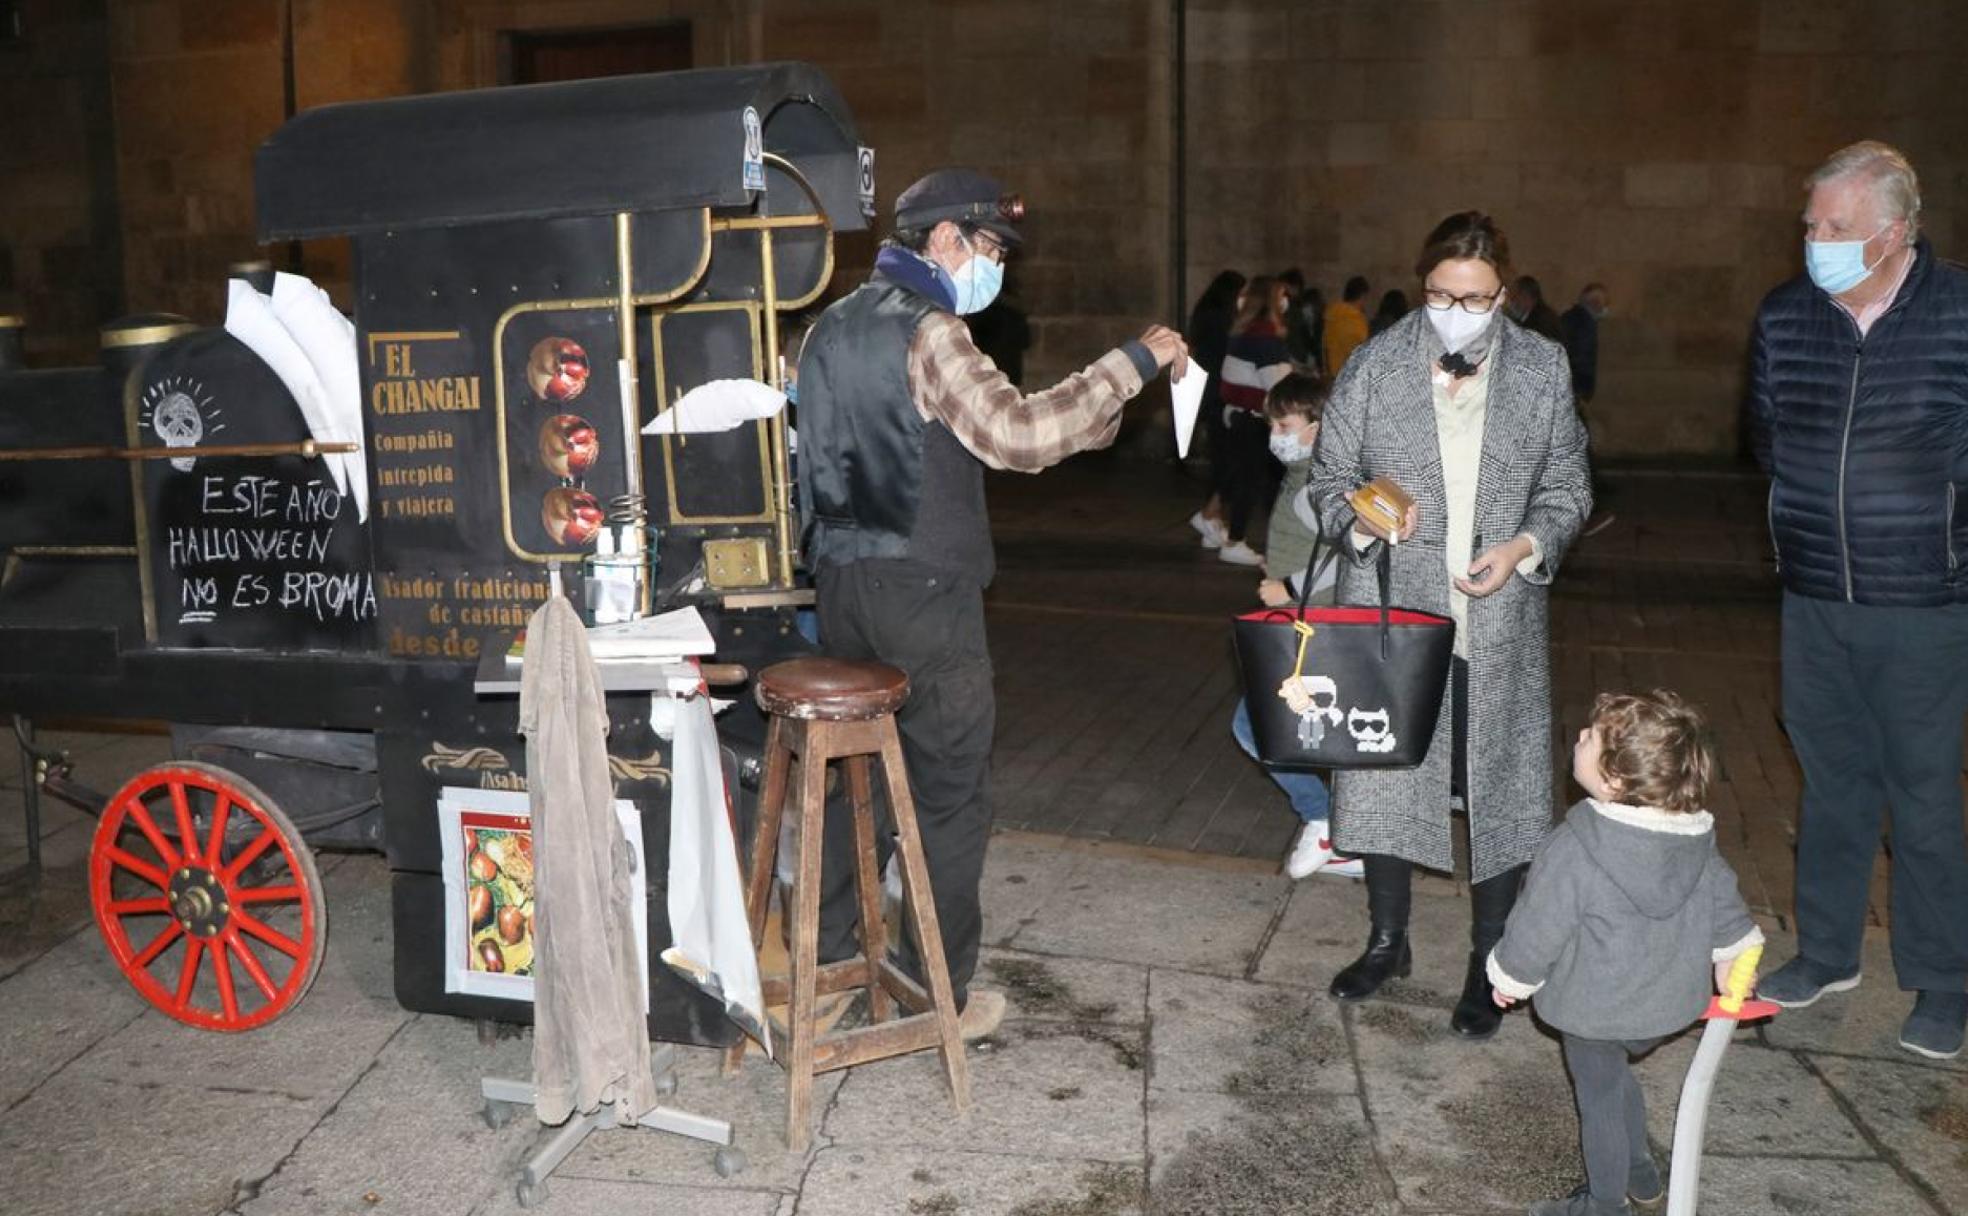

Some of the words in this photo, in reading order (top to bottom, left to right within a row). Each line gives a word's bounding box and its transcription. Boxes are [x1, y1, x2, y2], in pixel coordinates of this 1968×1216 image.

[385, 343, 416, 377] EL
[372, 375, 481, 415] CHANGAI
[202, 475, 280, 518] ESTE
[284, 478, 342, 523] AÑO
[397, 495, 454, 516] viajera
[168, 527, 333, 569] HALLOWEEN
[182, 575, 218, 609] NO
[231, 573, 270, 608] ES
[278, 570, 378, 622] BROMA
[455, 576, 552, 600] tradicion
[430, 602, 450, 625] de
[461, 603, 533, 626] castaña
[388, 627, 480, 659] desde
